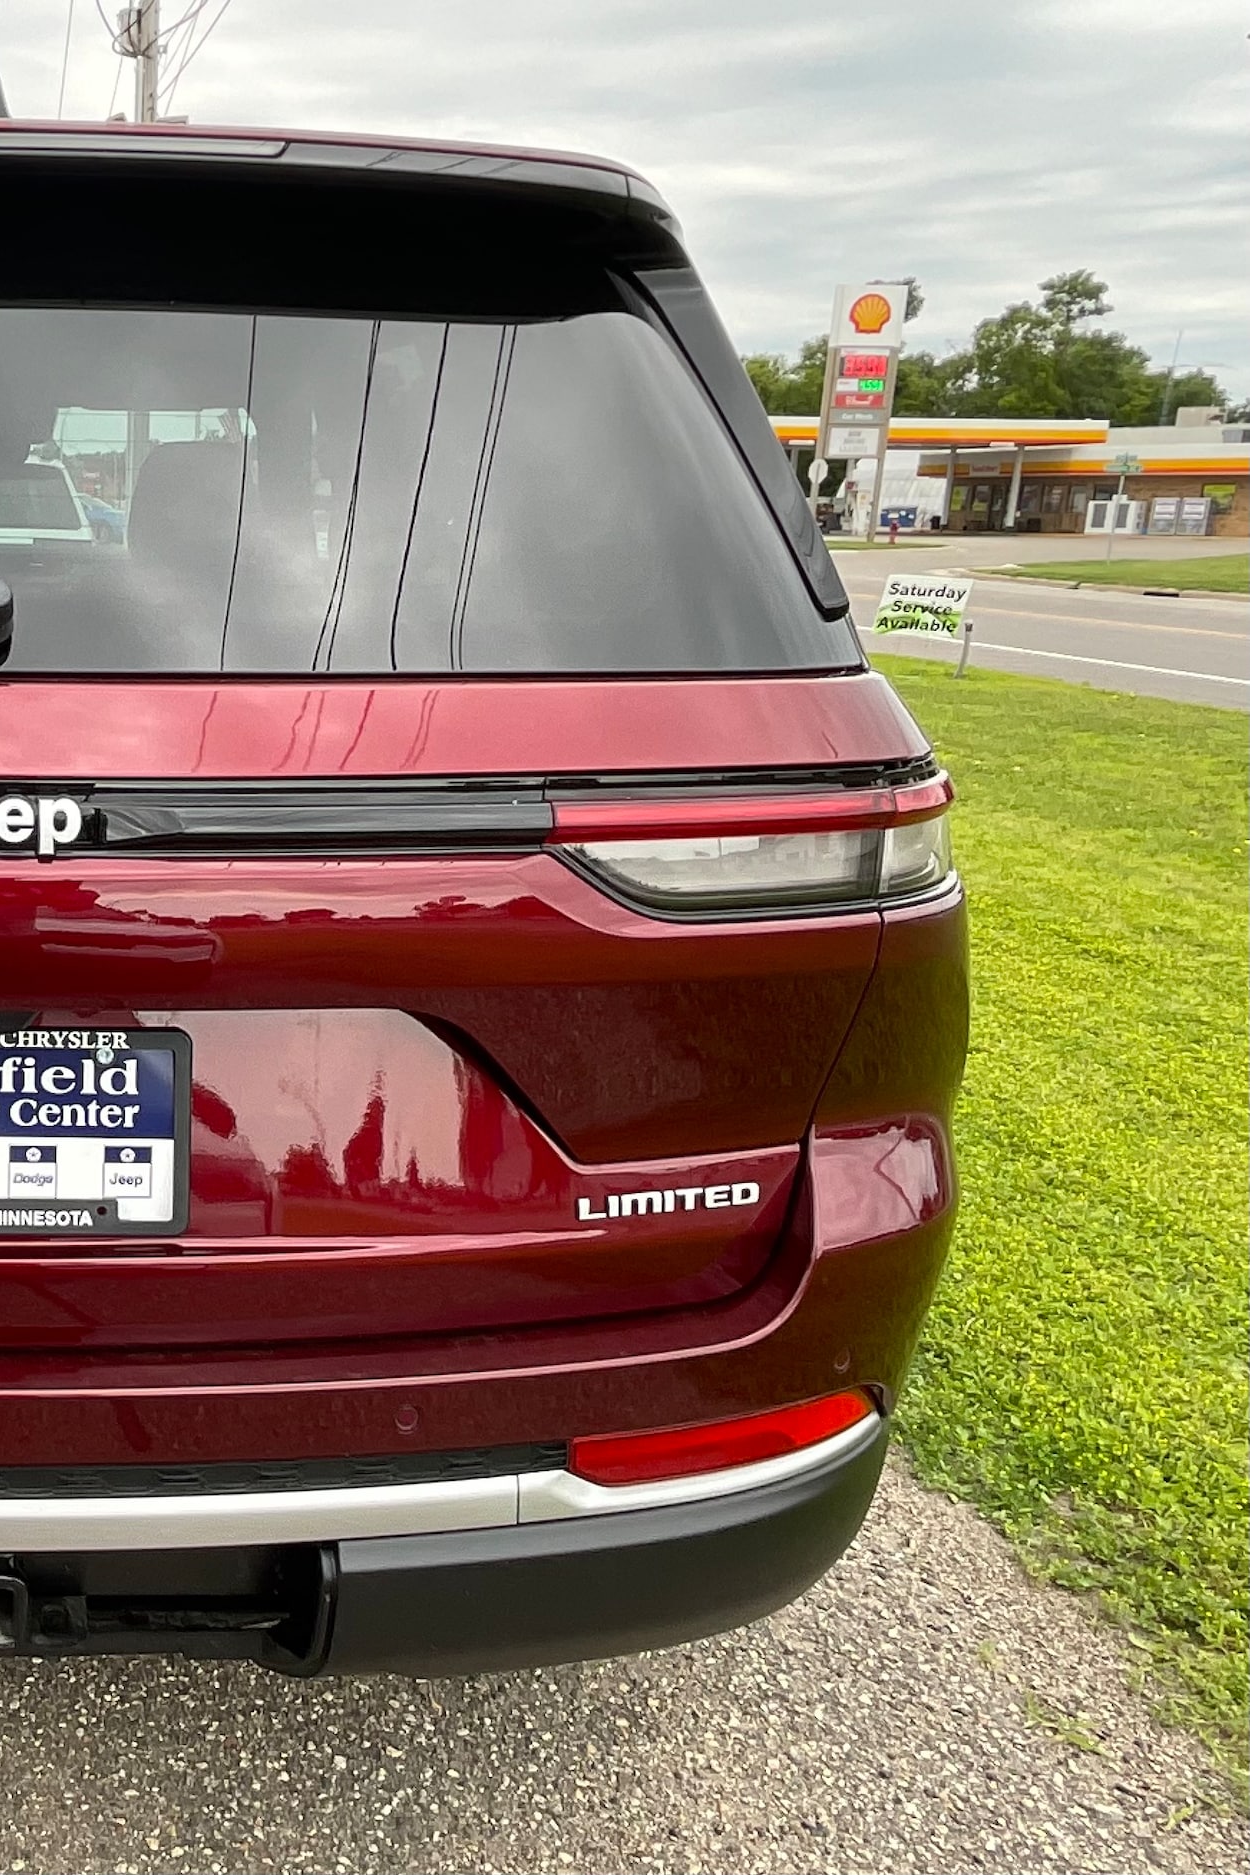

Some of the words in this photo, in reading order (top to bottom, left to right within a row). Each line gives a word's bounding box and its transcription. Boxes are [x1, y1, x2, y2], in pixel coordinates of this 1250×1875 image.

[888, 581, 967, 603] Saturday
[891, 599, 953, 616] Service
[876, 616, 957, 633] Available
[0, 1030, 130, 1049] CHRYSLER
[9, 1098, 141, 1128] Center
[13, 1173, 53, 1187] Dodge
[109, 1172, 143, 1187] Jeep
[578, 1182, 760, 1221] LIMITED
